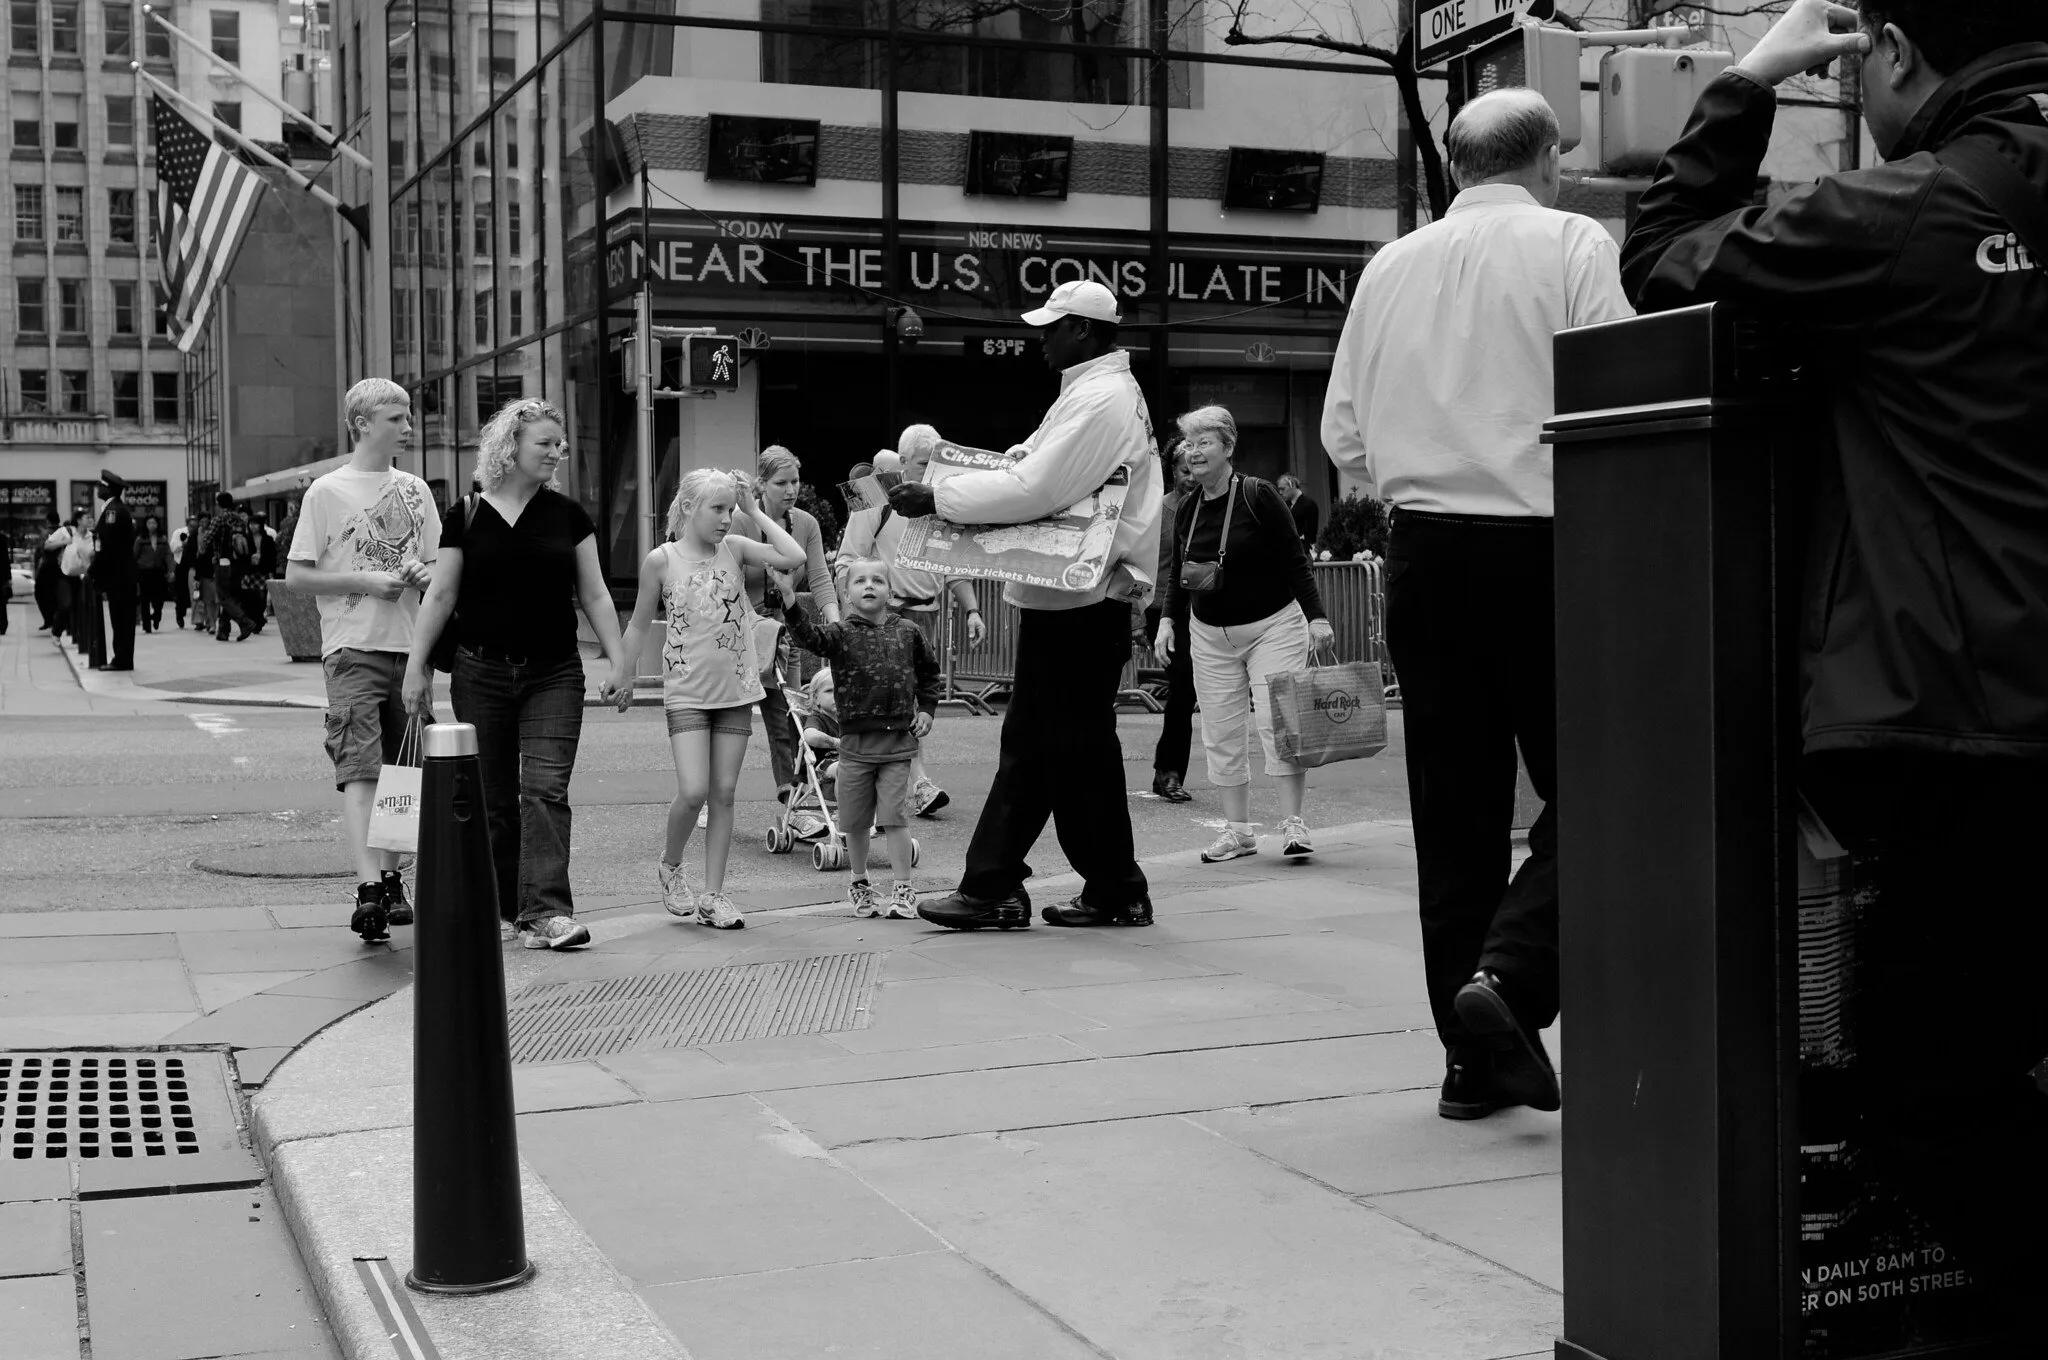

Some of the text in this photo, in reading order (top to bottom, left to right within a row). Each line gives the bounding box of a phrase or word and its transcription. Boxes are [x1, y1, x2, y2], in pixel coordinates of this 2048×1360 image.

[1432, 0, 1466, 39] ONE
[718, 219, 785, 240] TODAY
[968, 231, 1043, 250] NBC NEWS
[631, 240, 1346, 304] NEAR THE U.S. CONSLATE IN
[899, 555, 951, 574] Purchase
[954, 565, 981, 576] your
[984, 568, 1023, 581] tickets
[1026, 573, 1057, 587] here!
[1313, 695, 1361, 711] Hard Rock
[1818, 1258, 1870, 1283] DAILY
[1876, 1252, 1915, 1273] 8AM
[1921, 1247, 1946, 1266] TO
[1825, 1288, 1852, 1307] ON
[1858, 1279, 1904, 1302] 50TH
[1910, 1270, 1973, 1293] STREE
